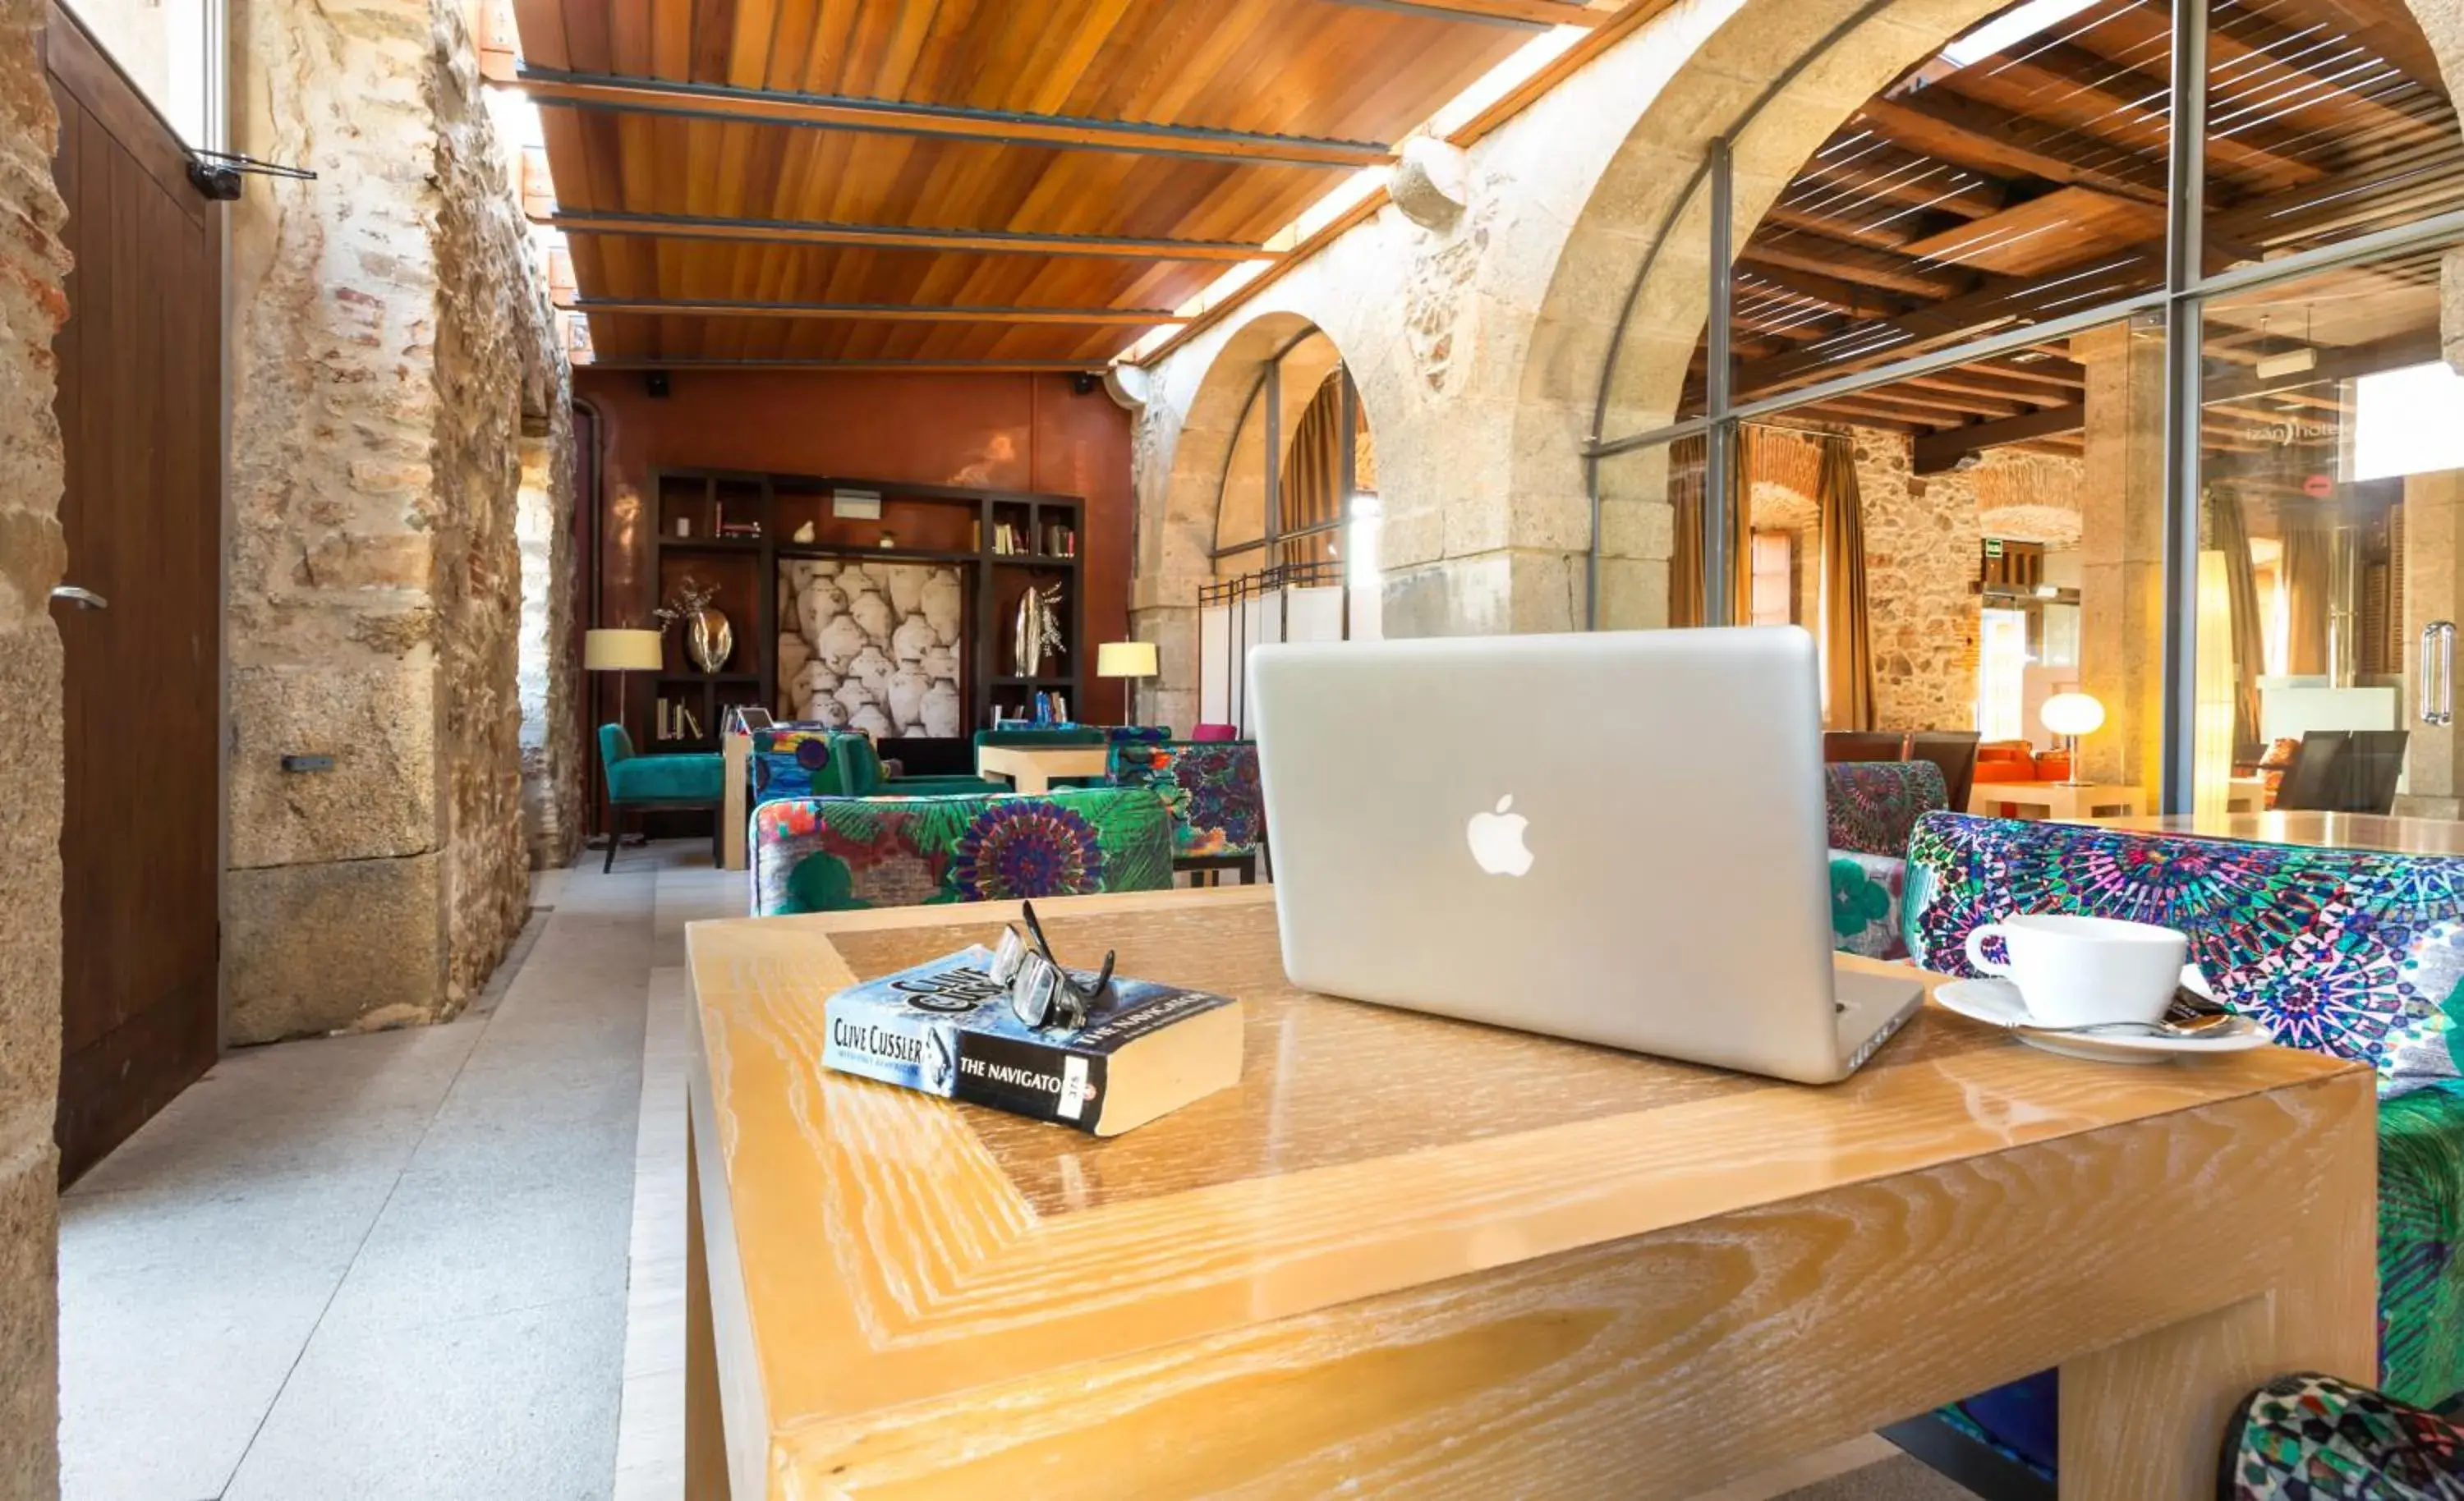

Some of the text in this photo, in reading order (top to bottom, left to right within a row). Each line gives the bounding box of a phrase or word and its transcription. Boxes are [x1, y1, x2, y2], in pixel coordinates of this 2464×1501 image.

[834, 1018, 866, 1051] CLIVE
[870, 1025, 922, 1063] CUSSLER
[960, 1057, 1062, 1093] THE NAVIGATO
